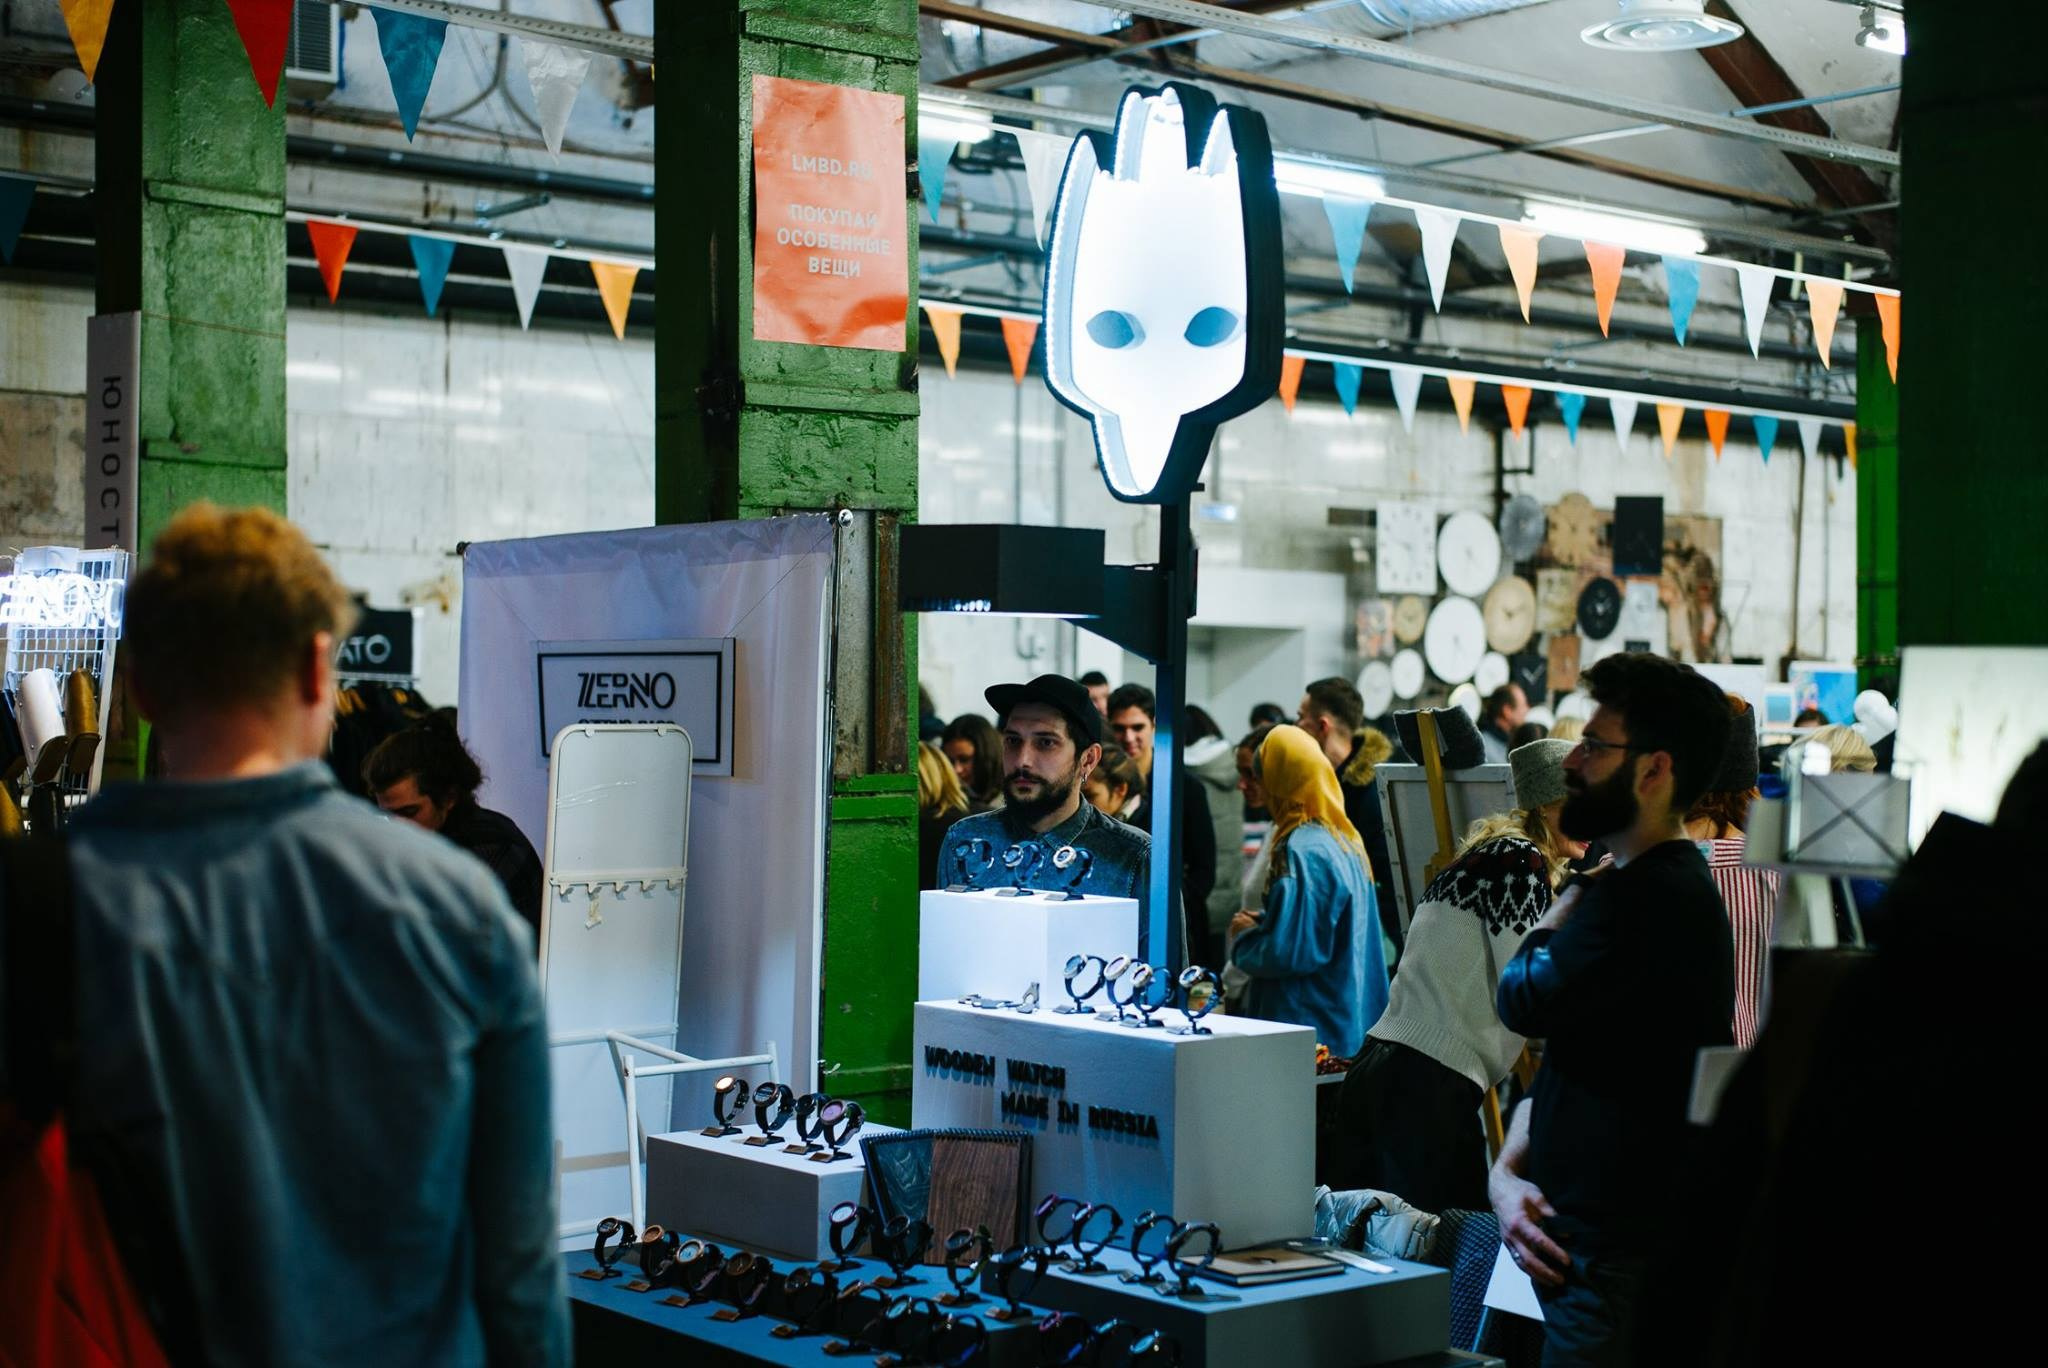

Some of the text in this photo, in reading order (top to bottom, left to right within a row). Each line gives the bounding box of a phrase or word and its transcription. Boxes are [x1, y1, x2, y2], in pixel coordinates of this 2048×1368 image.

[776, 227, 892, 255] ОСОБЕННЫЕ
[807, 256, 861, 278] ВЕЩИ
[101, 375, 122, 539] ЮНОСТ
[335, 633, 392, 665] ATO
[577, 671, 676, 710] ZERNO
[924, 1044, 1066, 1090] WOODEN WATCH
[1001, 1090, 1159, 1140] MADE IN RUSSIA
